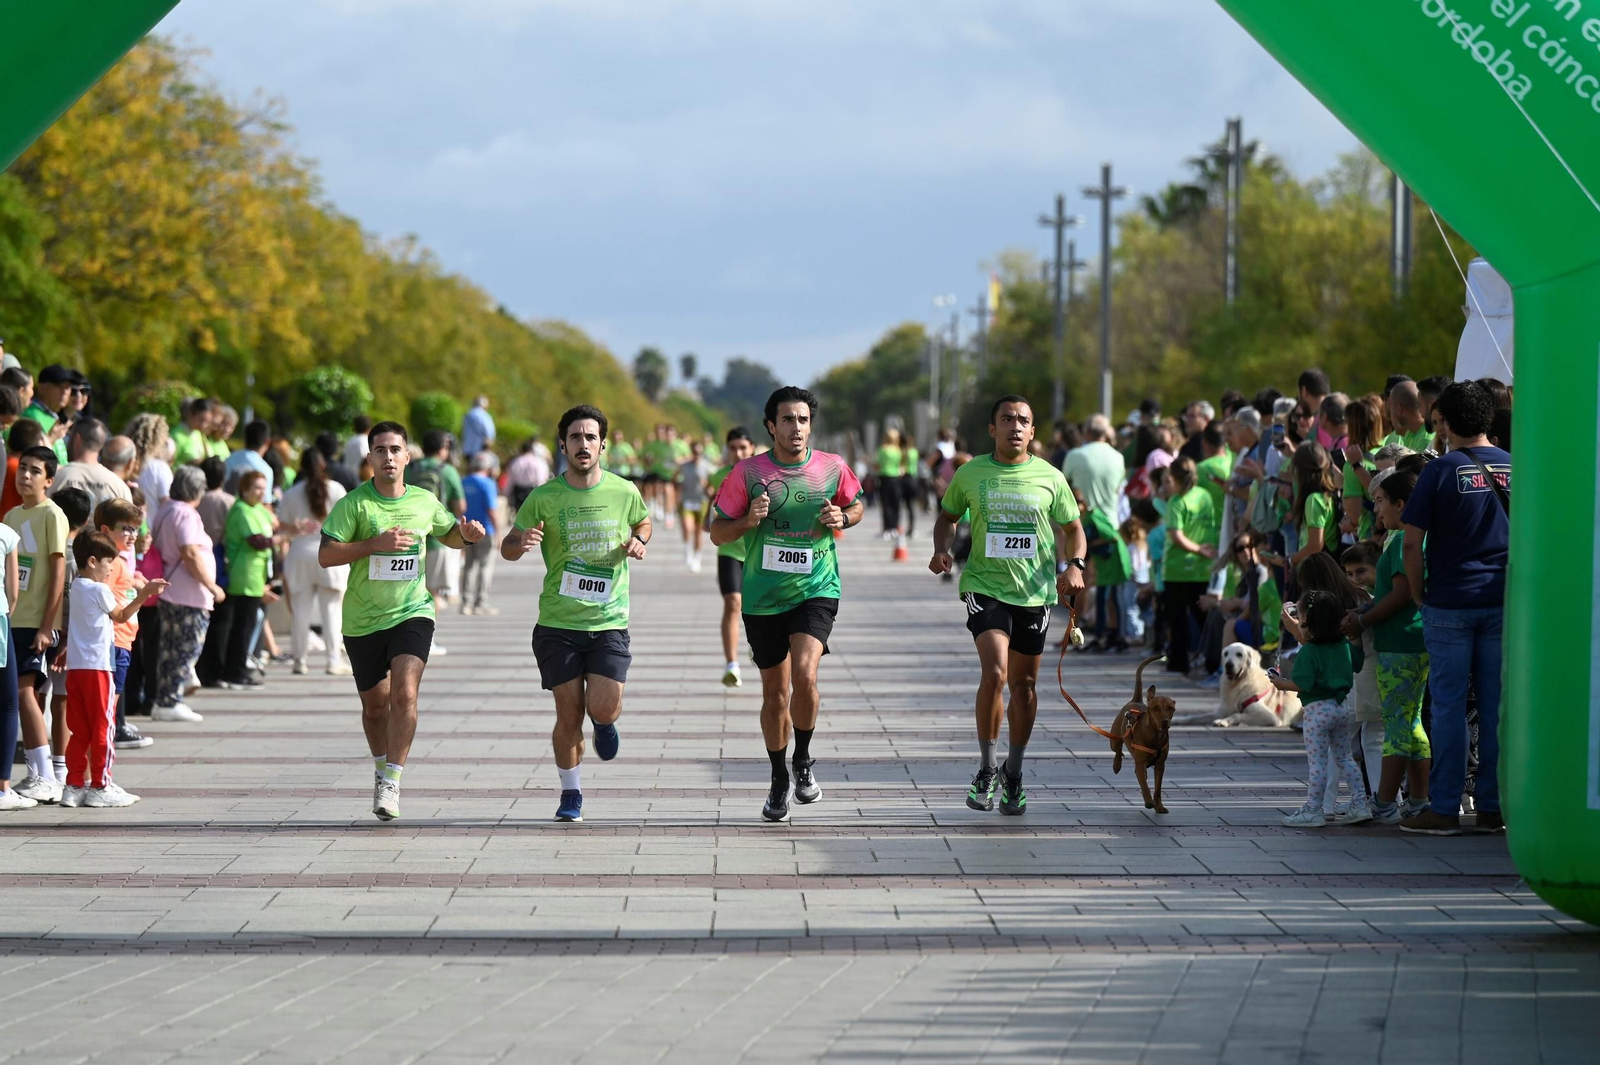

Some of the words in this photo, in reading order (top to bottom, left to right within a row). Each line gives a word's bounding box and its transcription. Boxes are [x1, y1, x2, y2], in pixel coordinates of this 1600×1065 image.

[988, 490, 1001, 500] En
[1003, 492, 1041, 502] marcha
[988, 502, 1024, 511] contra
[567, 521, 580, 530] En
[582, 518, 618, 528] marcha
[774, 520, 790, 530] La
[568, 529, 606, 541] contra
[607, 529, 617, 539] el
[570, 540, 617, 553] cáncer
[1004, 536, 1031, 549] 2218
[778, 550, 808, 564] 2005
[390, 559, 415, 572] 2217
[18, 569, 27, 582] 27
[578, 578, 606, 594] 0010
